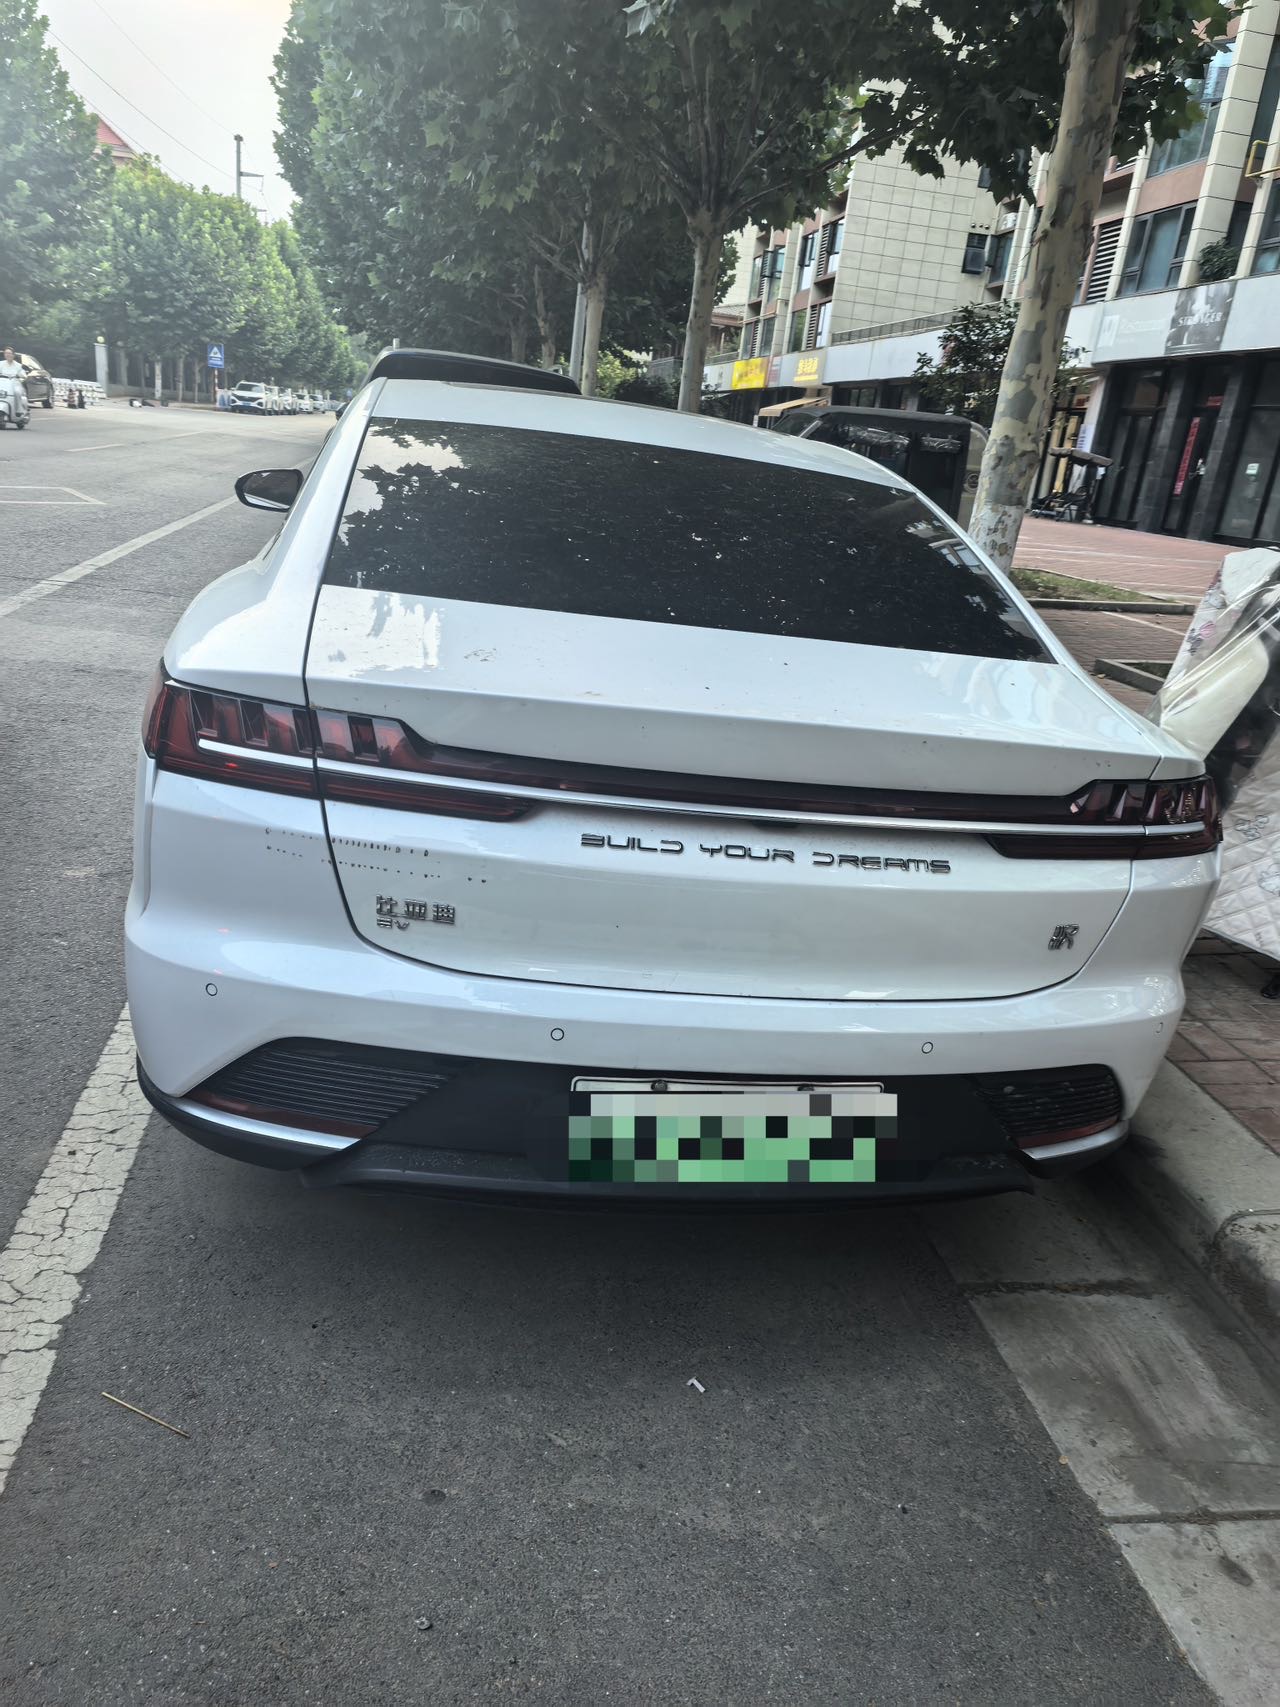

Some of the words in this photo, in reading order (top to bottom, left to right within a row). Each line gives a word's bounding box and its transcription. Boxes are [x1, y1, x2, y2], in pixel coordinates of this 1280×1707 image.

[581, 833, 685, 854] BUILD
[699, 843, 796, 863] YOUR
[811, 851, 951, 874] DREAMS
[376, 894, 456, 925] 比亚迪
[376, 917, 410, 931] EV
